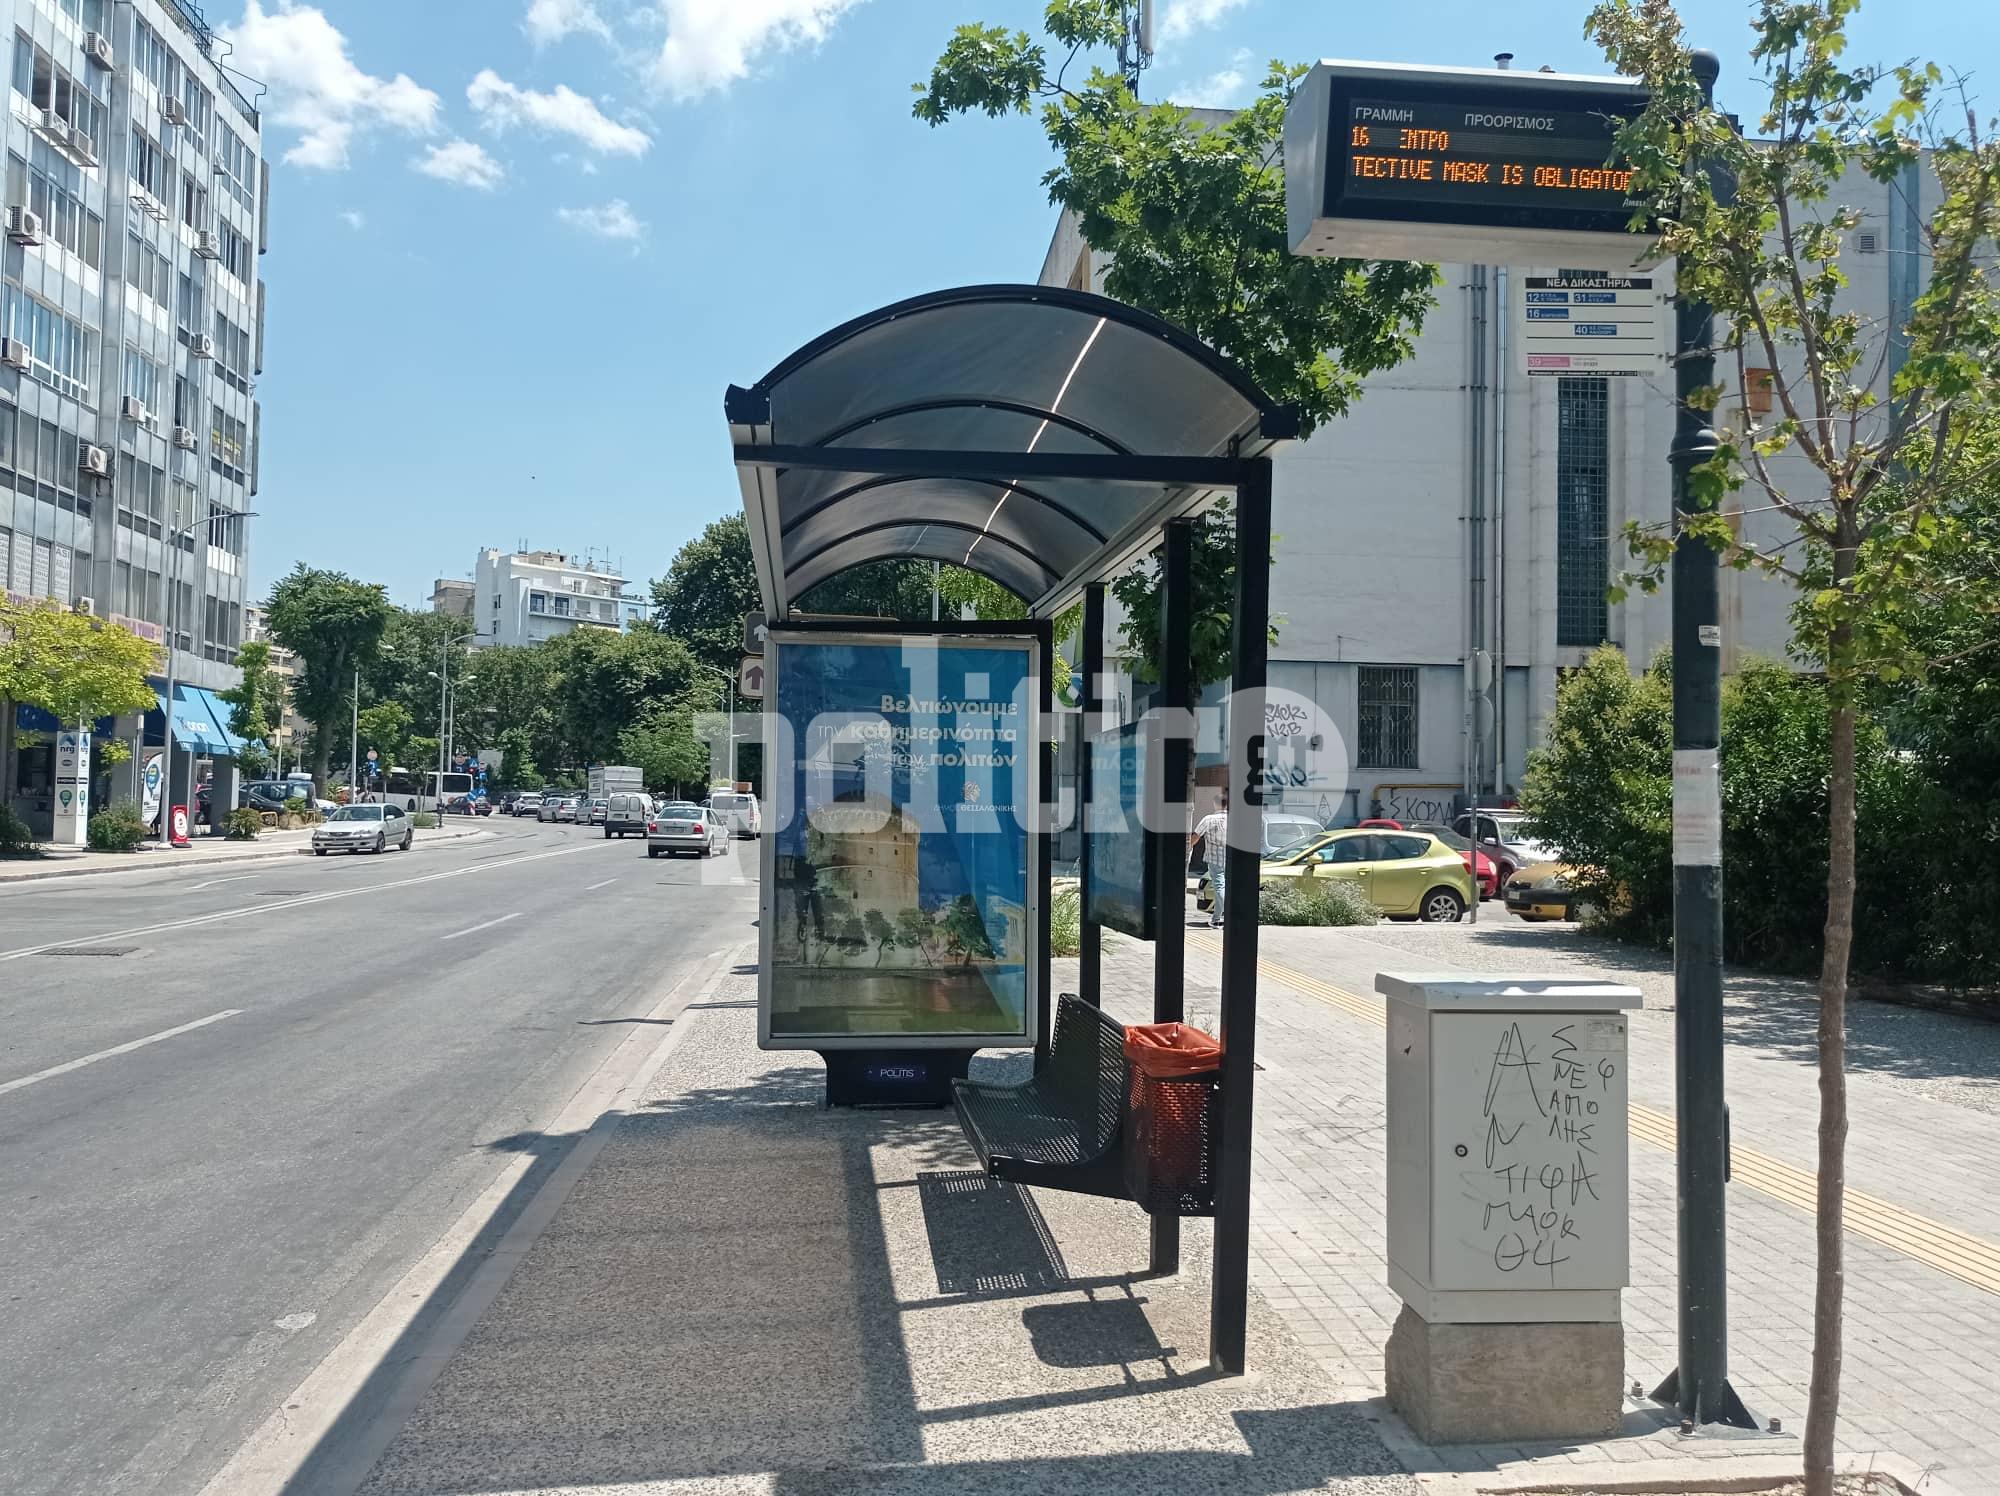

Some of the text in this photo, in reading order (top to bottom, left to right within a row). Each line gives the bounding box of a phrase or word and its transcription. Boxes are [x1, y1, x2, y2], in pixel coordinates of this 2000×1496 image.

[1355, 107, 1555, 131] ΓΡΑΜΜΗ ΠΡΟΟΡΙΣΜΟΣ
[1352, 126, 1370, 146] 16
[1352, 156, 1433, 180] TECTIVE
[1443, 161, 1490, 183] MASK
[1501, 164, 1524, 185] IS
[1546, 278, 1632, 288] ΝΕΑ ΔΙΚΑΣΤΗΡΙΑ
[1527, 293, 1540, 302] 12
[1574, 293, 1586, 303] 31
[1527, 309, 1540, 318] 16
[1575, 326, 1588, 335] 40
[881, 694, 1018, 721] Βελτιώνουμε
[928, 747, 1017, 767] πολιτών
[960, 804, 1017, 812] ΘΕΣΣΑΛΟΝΙΚΗΣ
[880, 1068, 915, 1078] POLITIS
